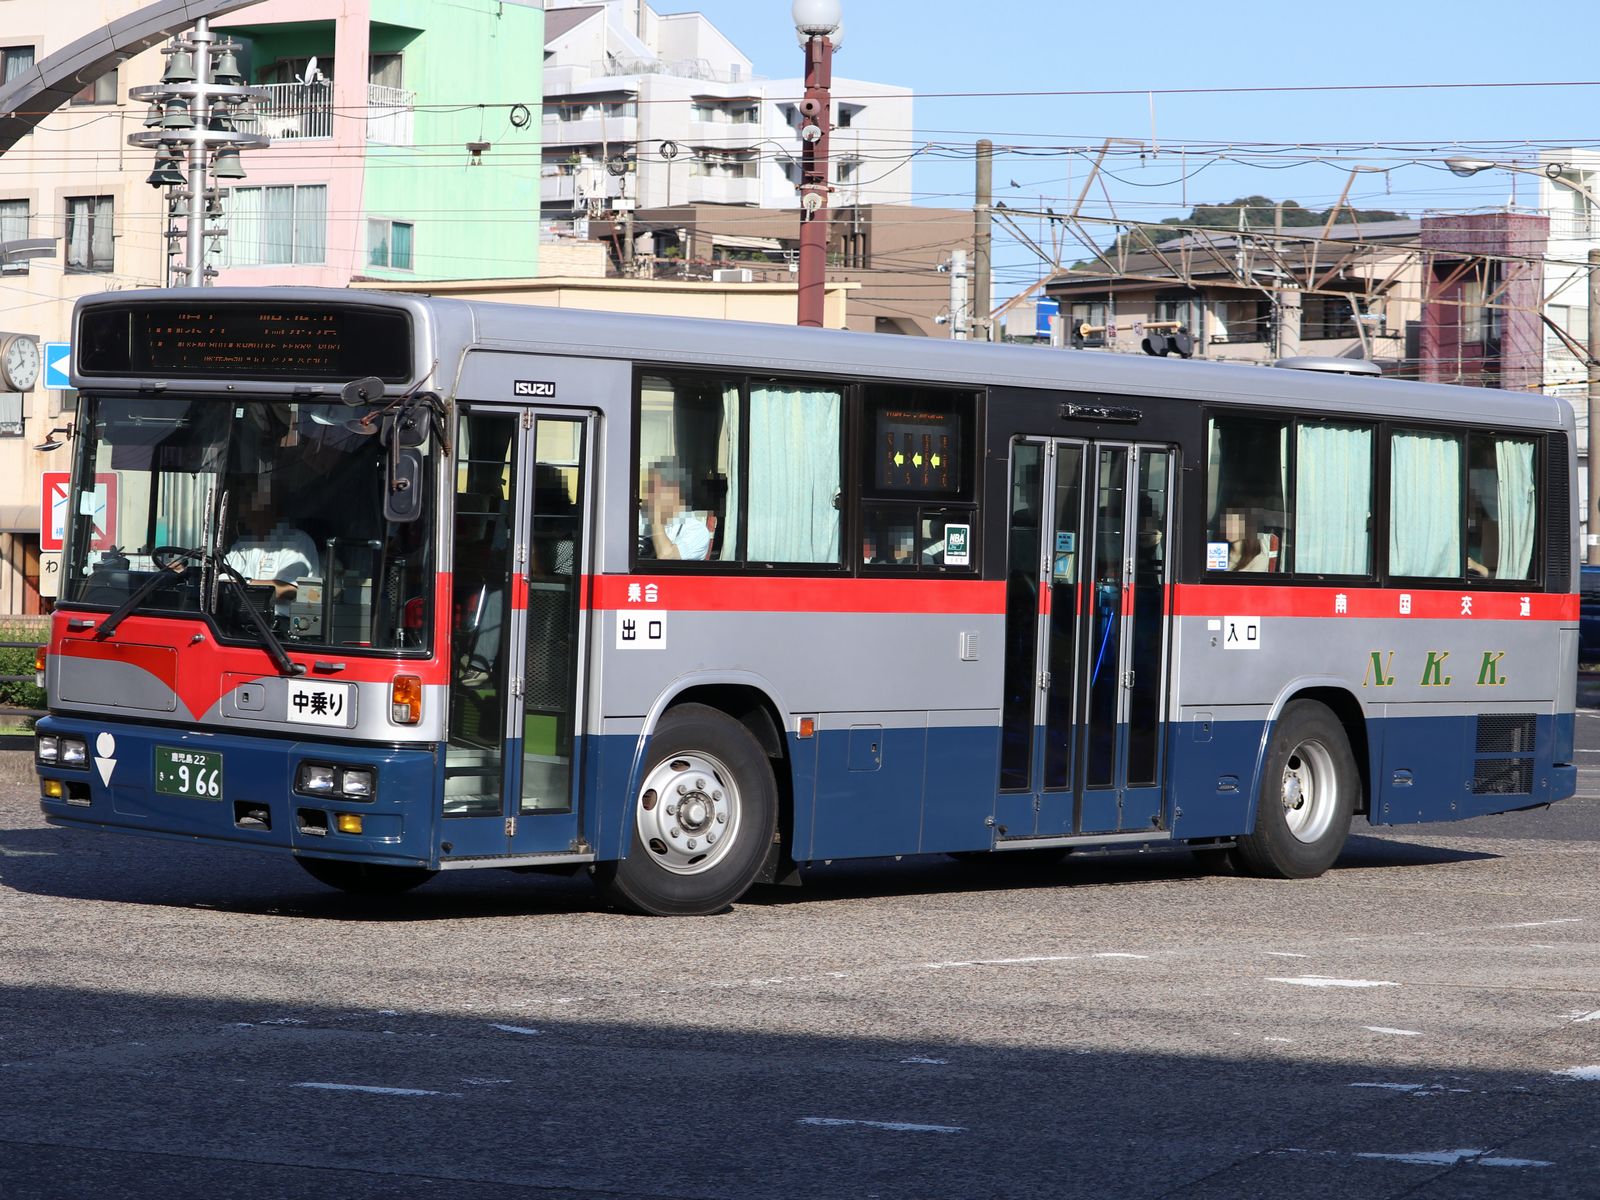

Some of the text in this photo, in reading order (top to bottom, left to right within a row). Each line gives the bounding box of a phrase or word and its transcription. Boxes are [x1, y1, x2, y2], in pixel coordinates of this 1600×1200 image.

[515, 382, 554, 395] ISUZU
[627, 583, 659, 603] 乗合
[622, 618, 662, 640] 出口
[1227, 623, 1257, 641] 入口
[293, 690, 343, 717] 中乗り
